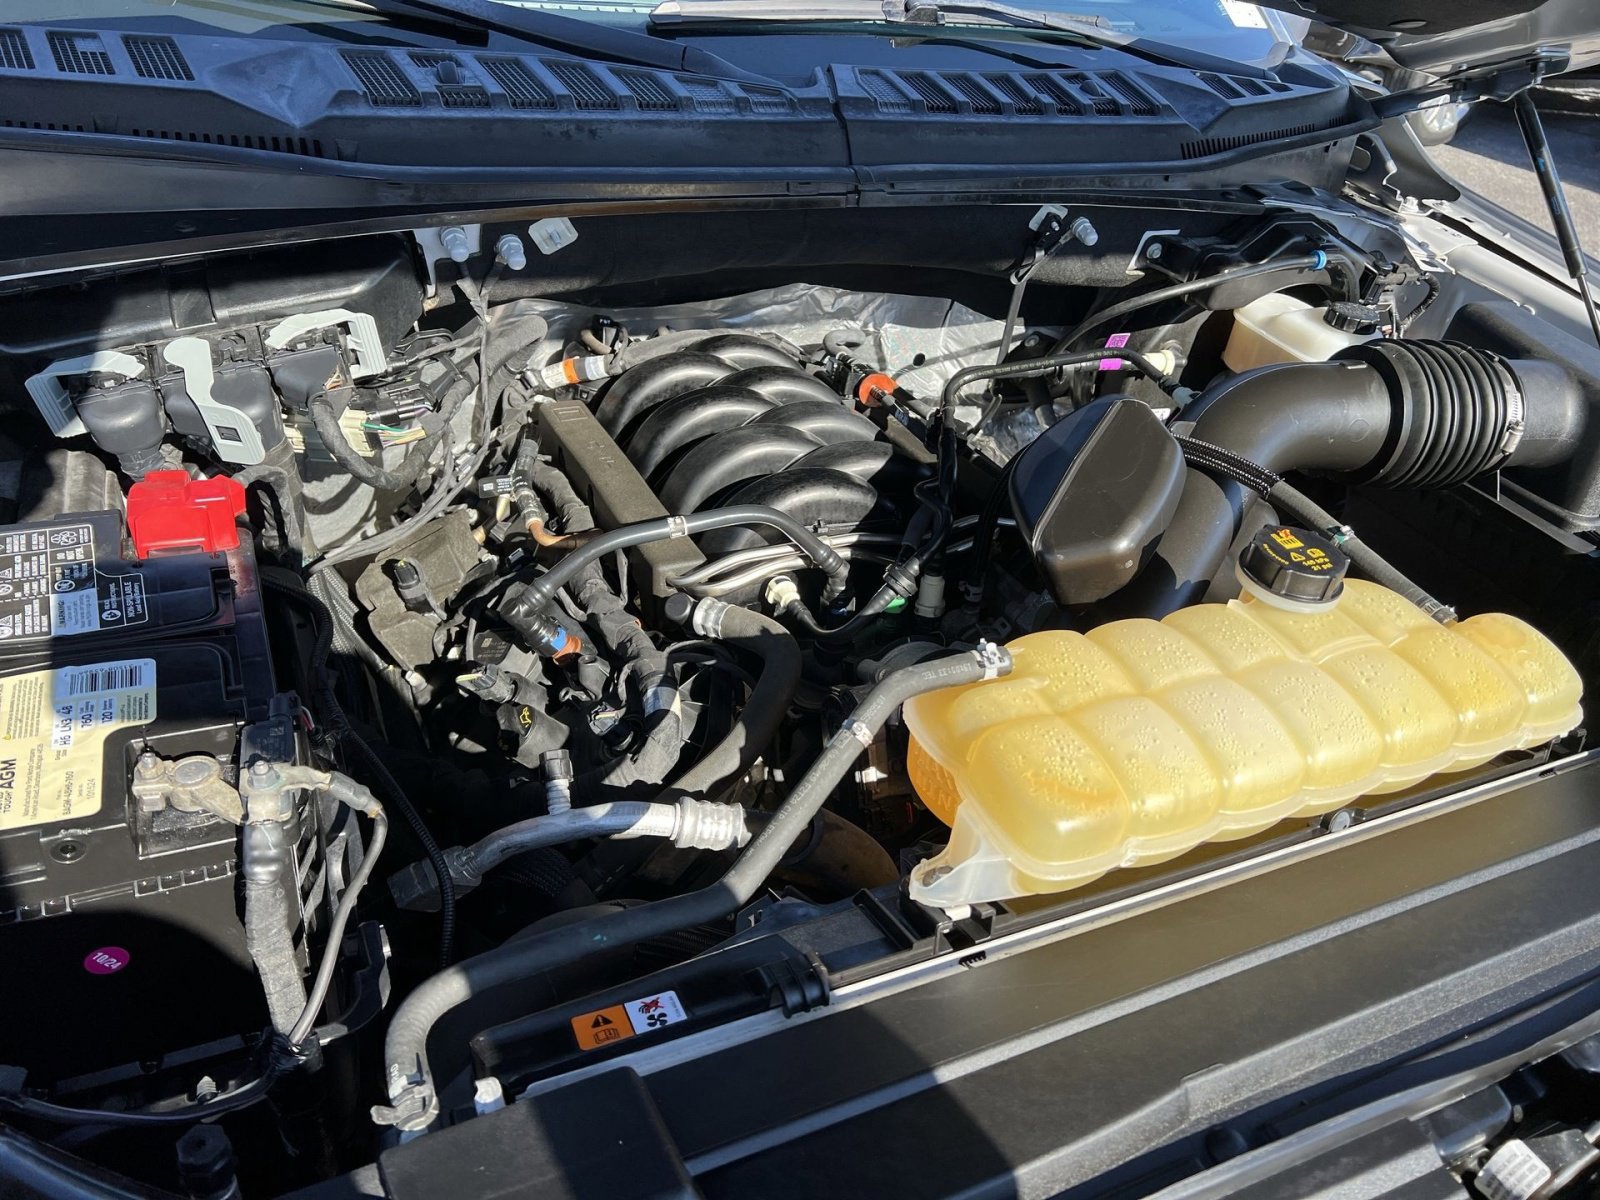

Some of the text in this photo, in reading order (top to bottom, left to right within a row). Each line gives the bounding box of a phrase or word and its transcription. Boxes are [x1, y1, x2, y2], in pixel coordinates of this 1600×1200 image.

[124, 582, 135, 617] NON-SPILLABLE
[60, 705, 72, 745] H6 LN3 48
[81, 714, 92, 728] 760
[102, 711, 113, 723] 120
[0, 759, 16, 789] AGM
[92, 952, 122, 970] 10/24
